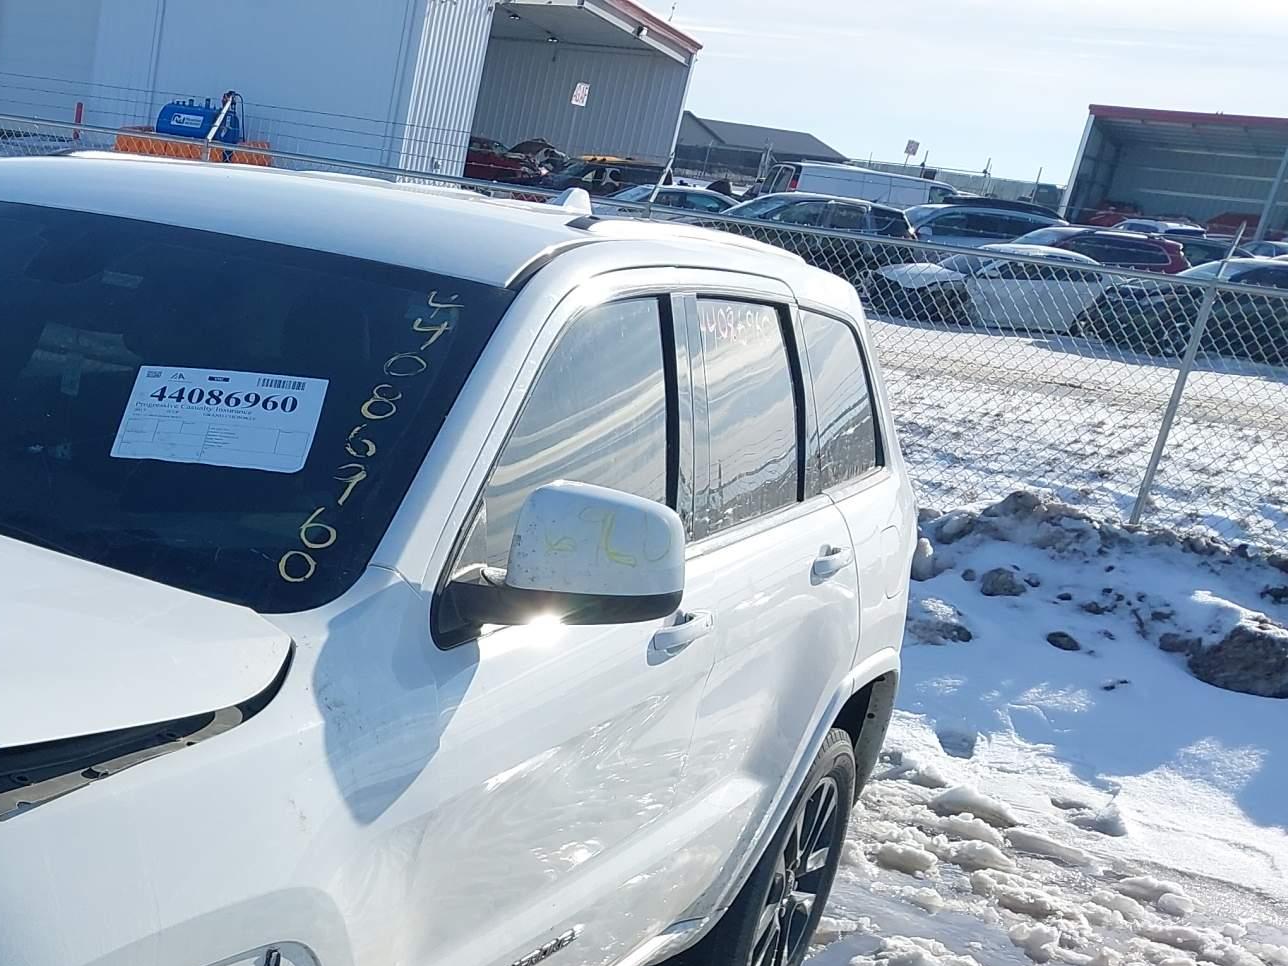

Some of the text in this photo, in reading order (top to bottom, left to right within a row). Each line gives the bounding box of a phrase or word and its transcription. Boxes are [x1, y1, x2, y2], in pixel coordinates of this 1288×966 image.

[134, 400, 254, 416] Progressive Casualty Insurance
[149, 385, 299, 413] 44086960
